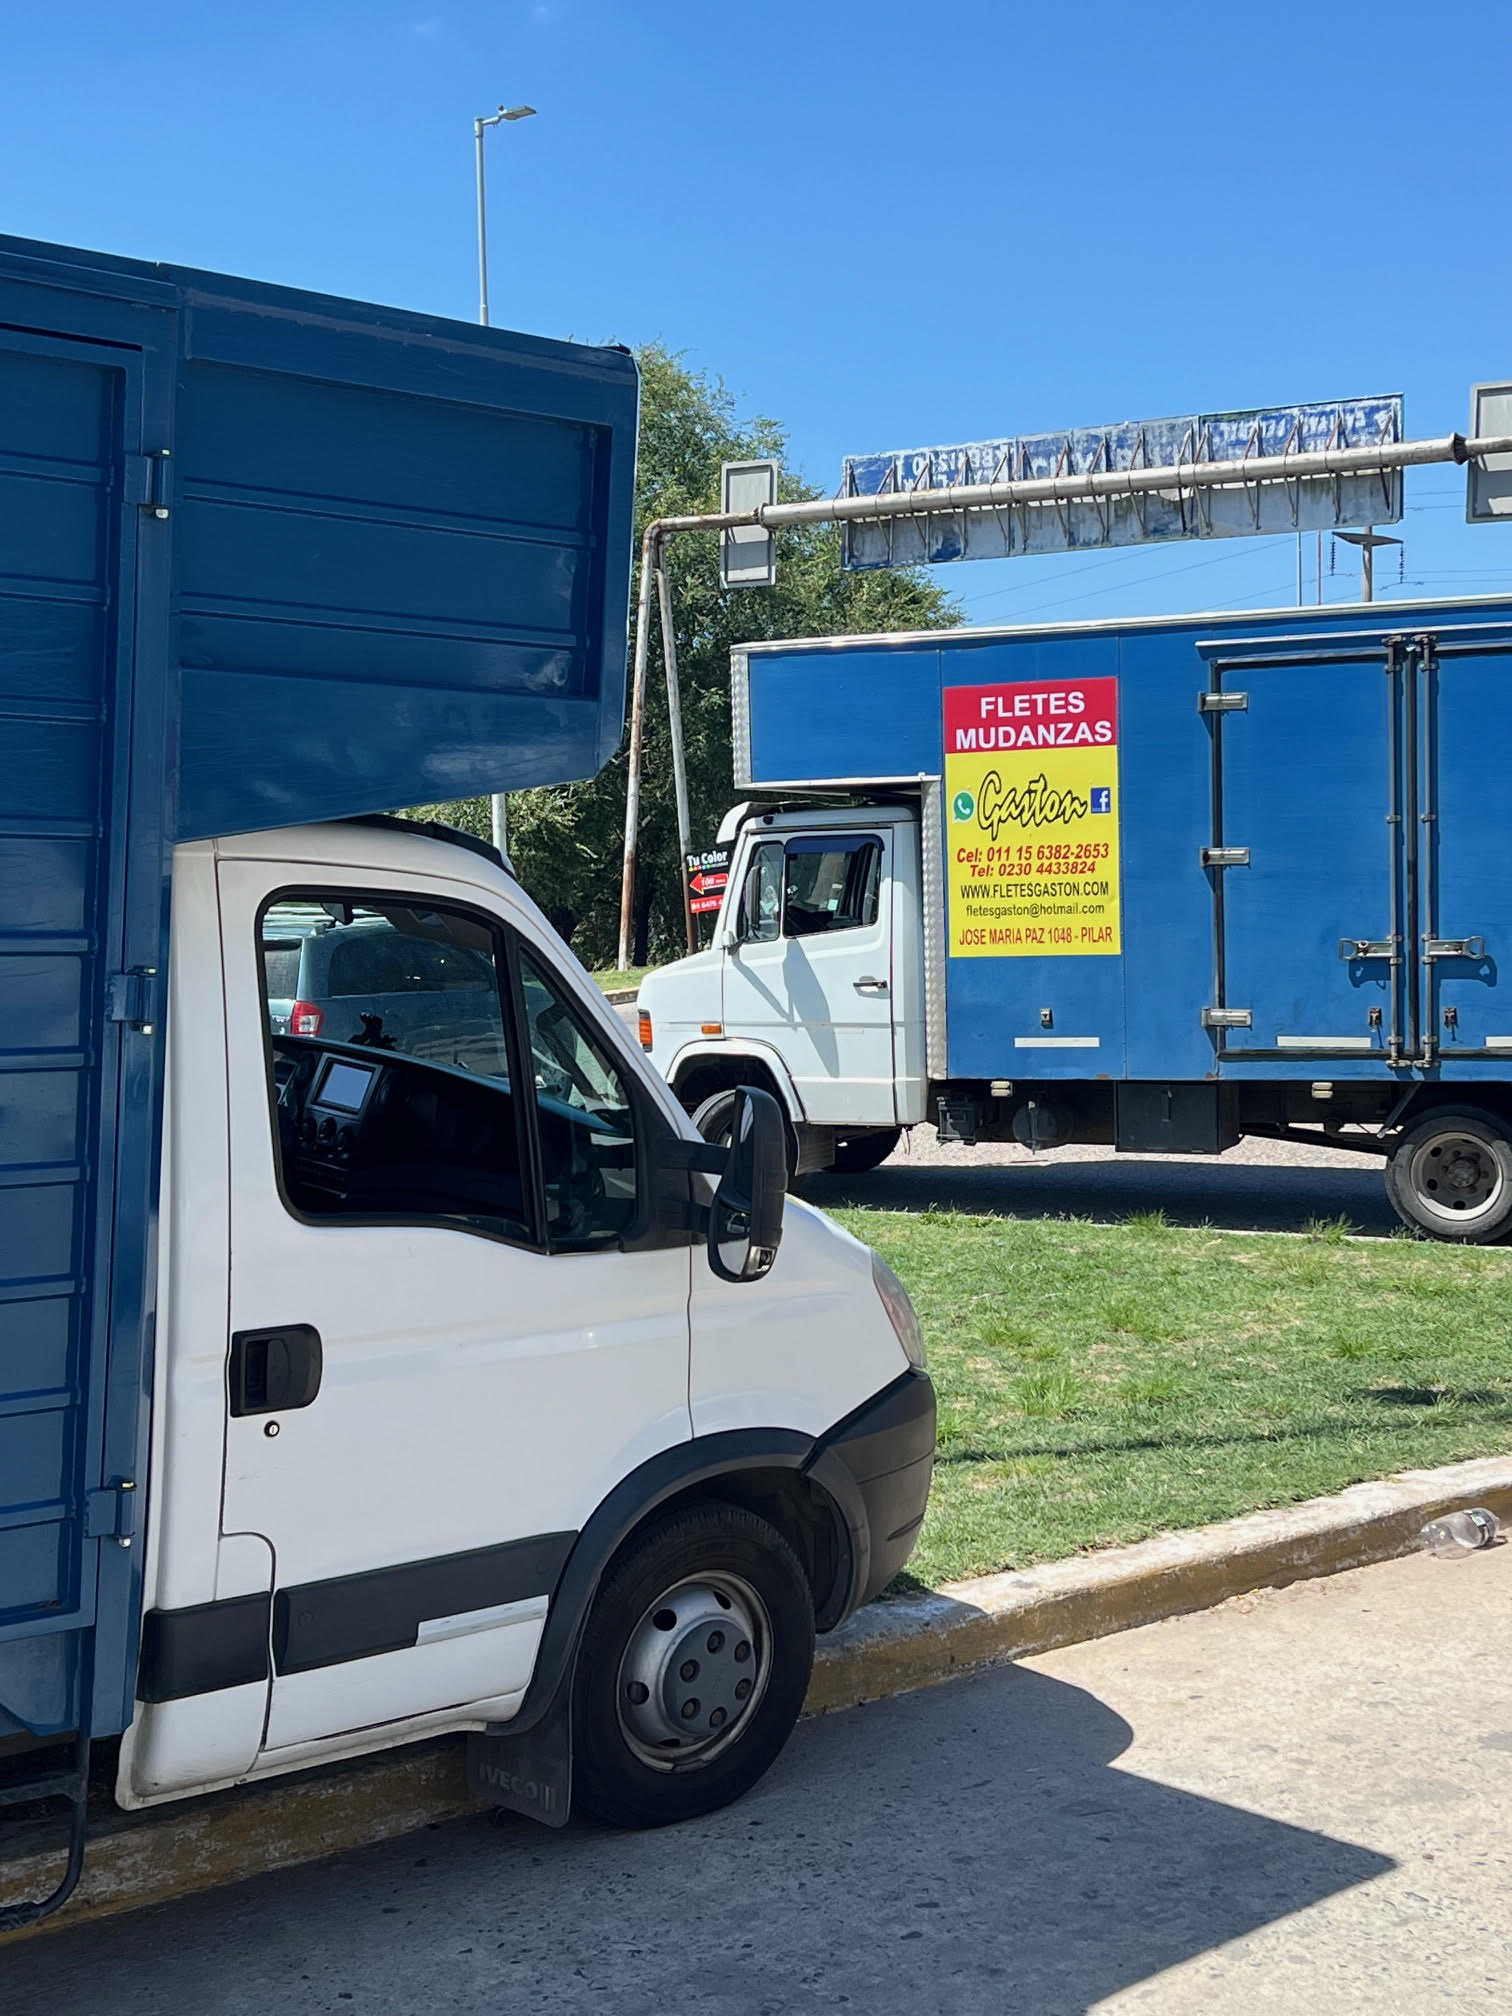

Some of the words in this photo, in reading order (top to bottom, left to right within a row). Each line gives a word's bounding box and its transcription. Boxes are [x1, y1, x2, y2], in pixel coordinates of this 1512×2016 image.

[980, 691, 1085, 718] FLETES
[956, 720, 1112, 750] MUDANZAS
[977, 770, 1087, 841] Gaston
[687, 855, 700, 866] Tu
[701, 850, 728, 864] Color
[957, 848, 982, 863] Cel:
[986, 847, 1011, 862] 011
[1016, 845, 1032, 861] 15
[1037, 842, 1110, 860] 6382-2653
[970, 864, 993, 877] Tel:
[998, 863, 1032, 876] 0230
[1035, 861, 1096, 875] 4433824
[960, 881, 1109, 899] WWW.FLETESGASTON.COM
[966, 903, 1105, 919] fletesgaston@hotmail.com
[959, 928, 986, 945] JOSE
[989, 928, 1021, 944] MARIA
[1026, 927, 1044, 944] PAZ
[1048, 927, 1072, 943] 1048
[1081, 926, 1112, 943] PILAR
